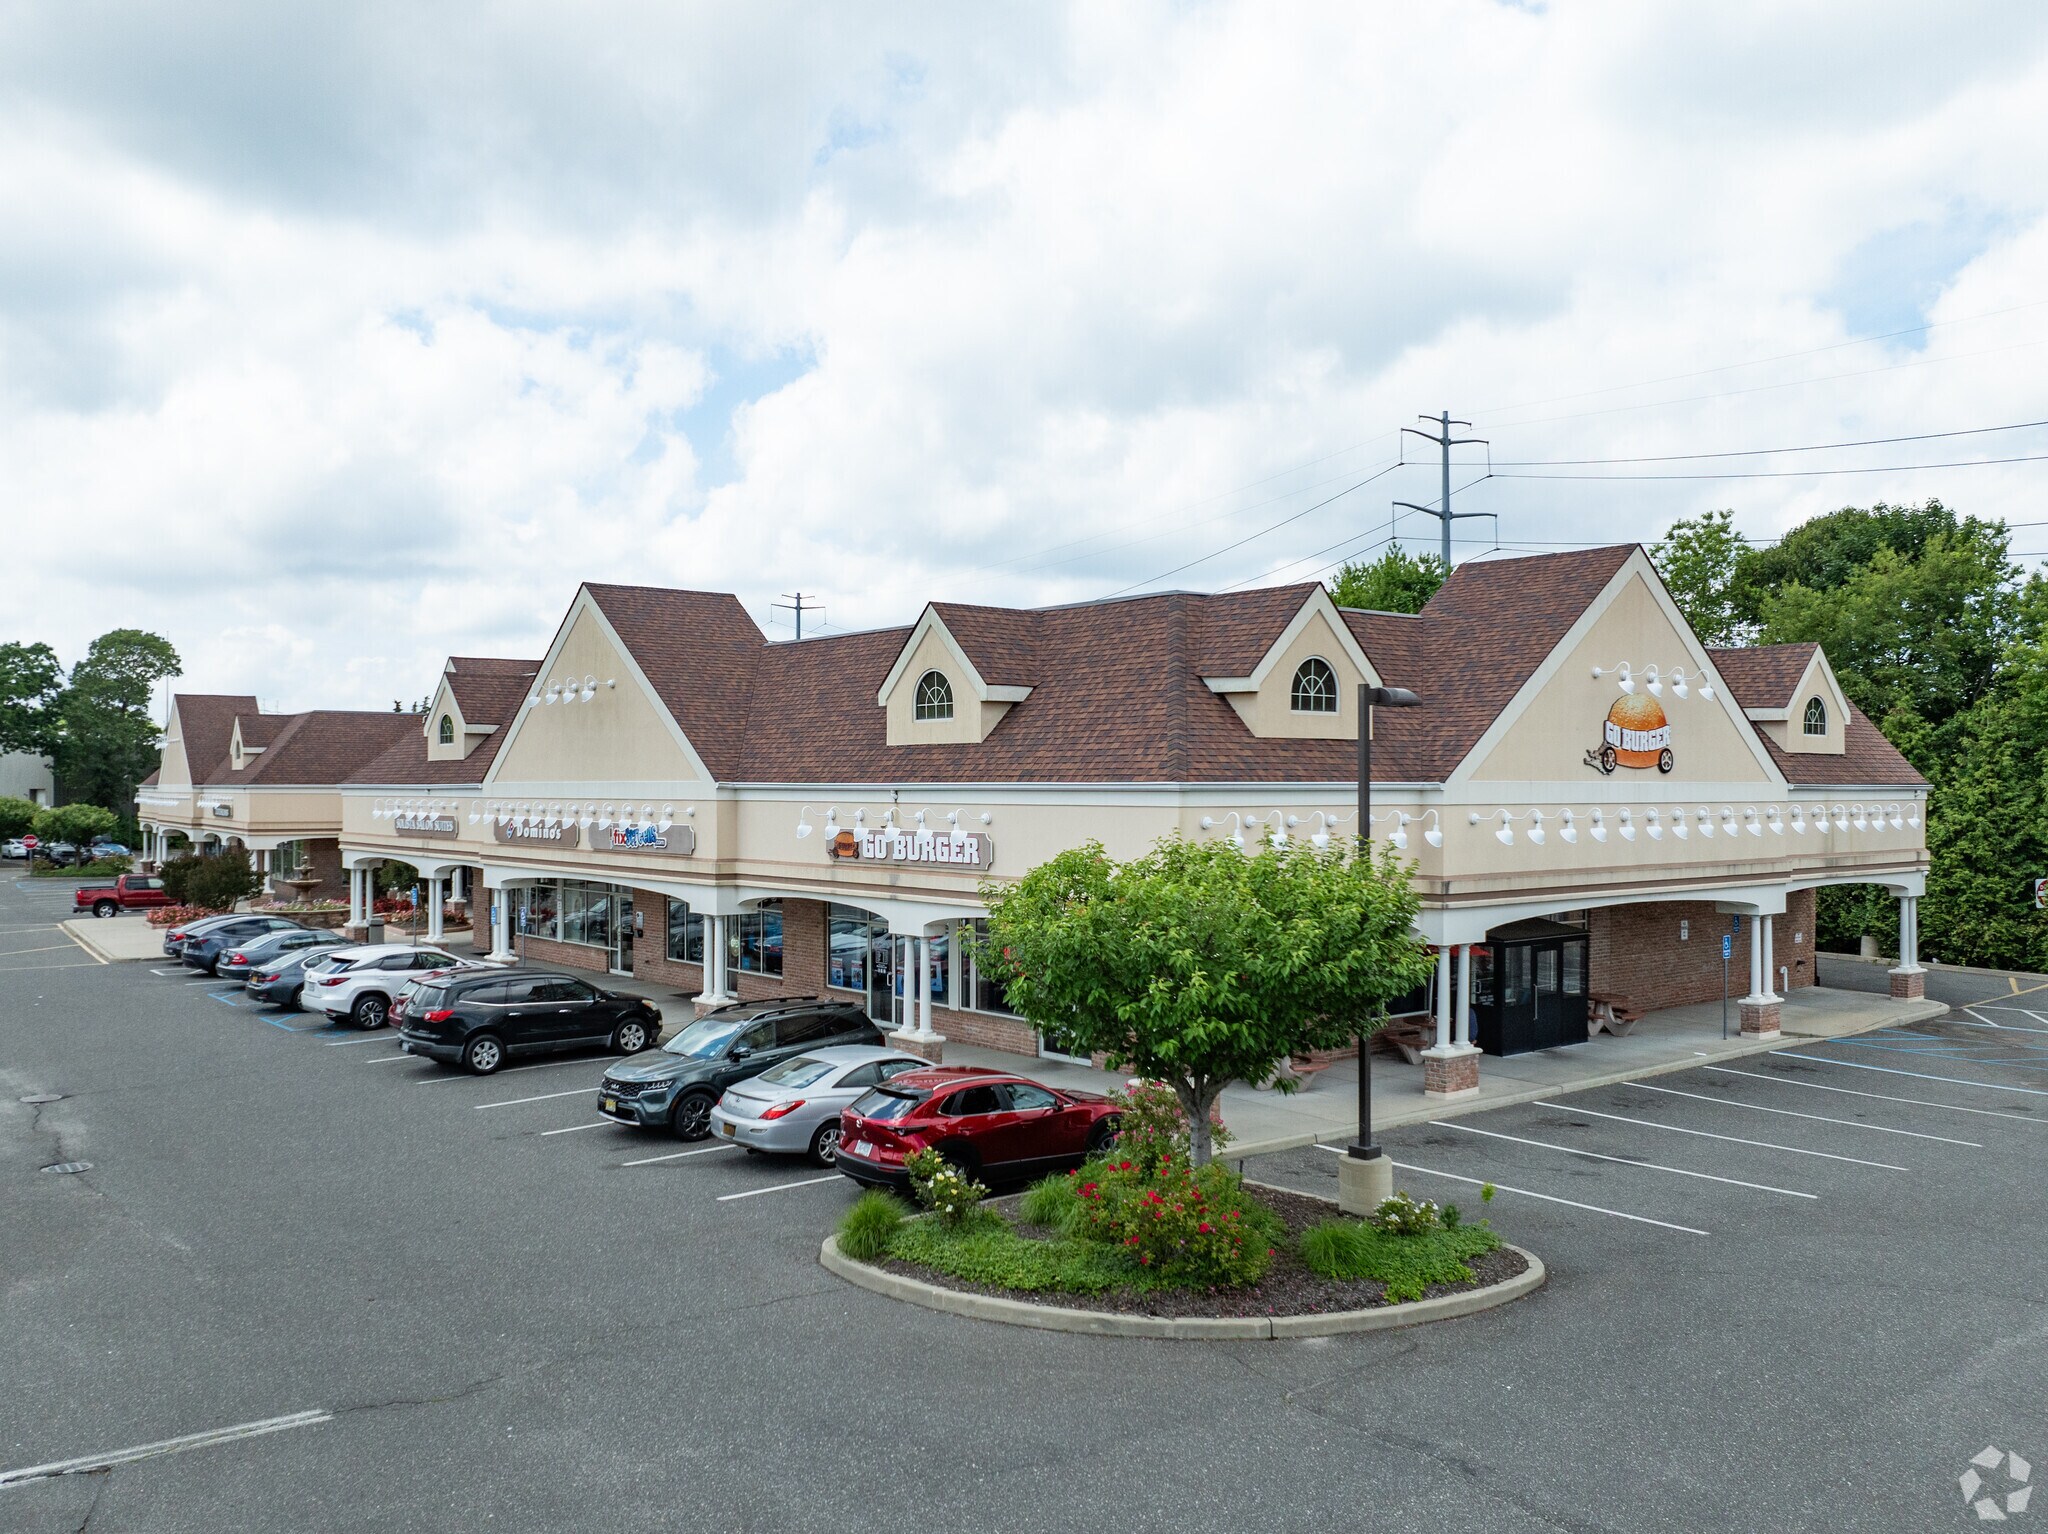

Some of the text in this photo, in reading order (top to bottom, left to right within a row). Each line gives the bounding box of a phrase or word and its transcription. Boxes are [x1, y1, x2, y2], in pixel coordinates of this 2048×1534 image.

[1605, 720, 1670, 752] GO BURGER
[862, 833, 980, 864] GO BURGER
